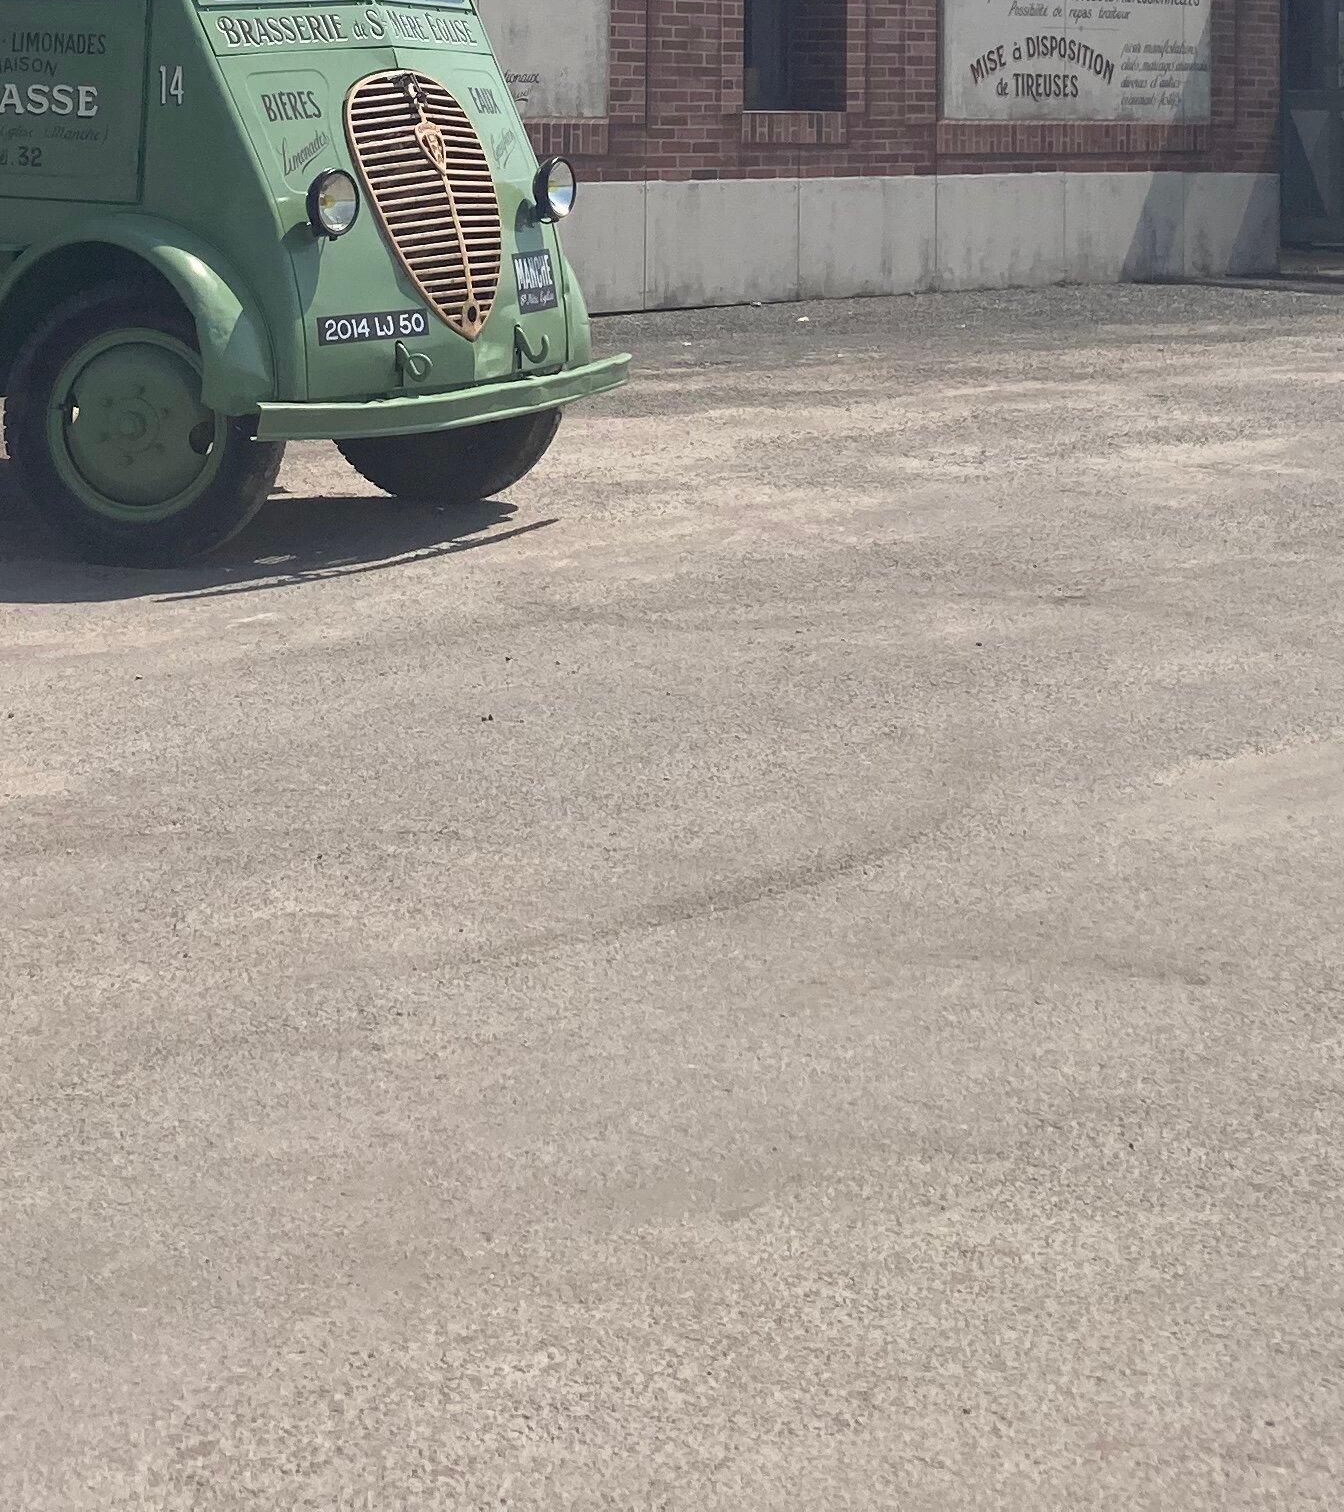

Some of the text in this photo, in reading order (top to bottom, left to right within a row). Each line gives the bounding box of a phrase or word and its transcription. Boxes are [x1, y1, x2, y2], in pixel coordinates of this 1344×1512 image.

[12, 31, 107, 55] LIMONADES
[217, 14, 349, 48] BRASSERIE
[970, 44, 1007, 85] MISE
[1025, 35, 1115, 86] DISPOSITION
[160, 65, 185, 106] 14
[996, 73, 1079, 102] de TIREUSES
[467, 86, 501, 115] EAUX
[17, 146, 42, 167] 32
[514, 254, 553, 291] MANCHE
[324, 312, 425, 341] 2014 LJ 50
